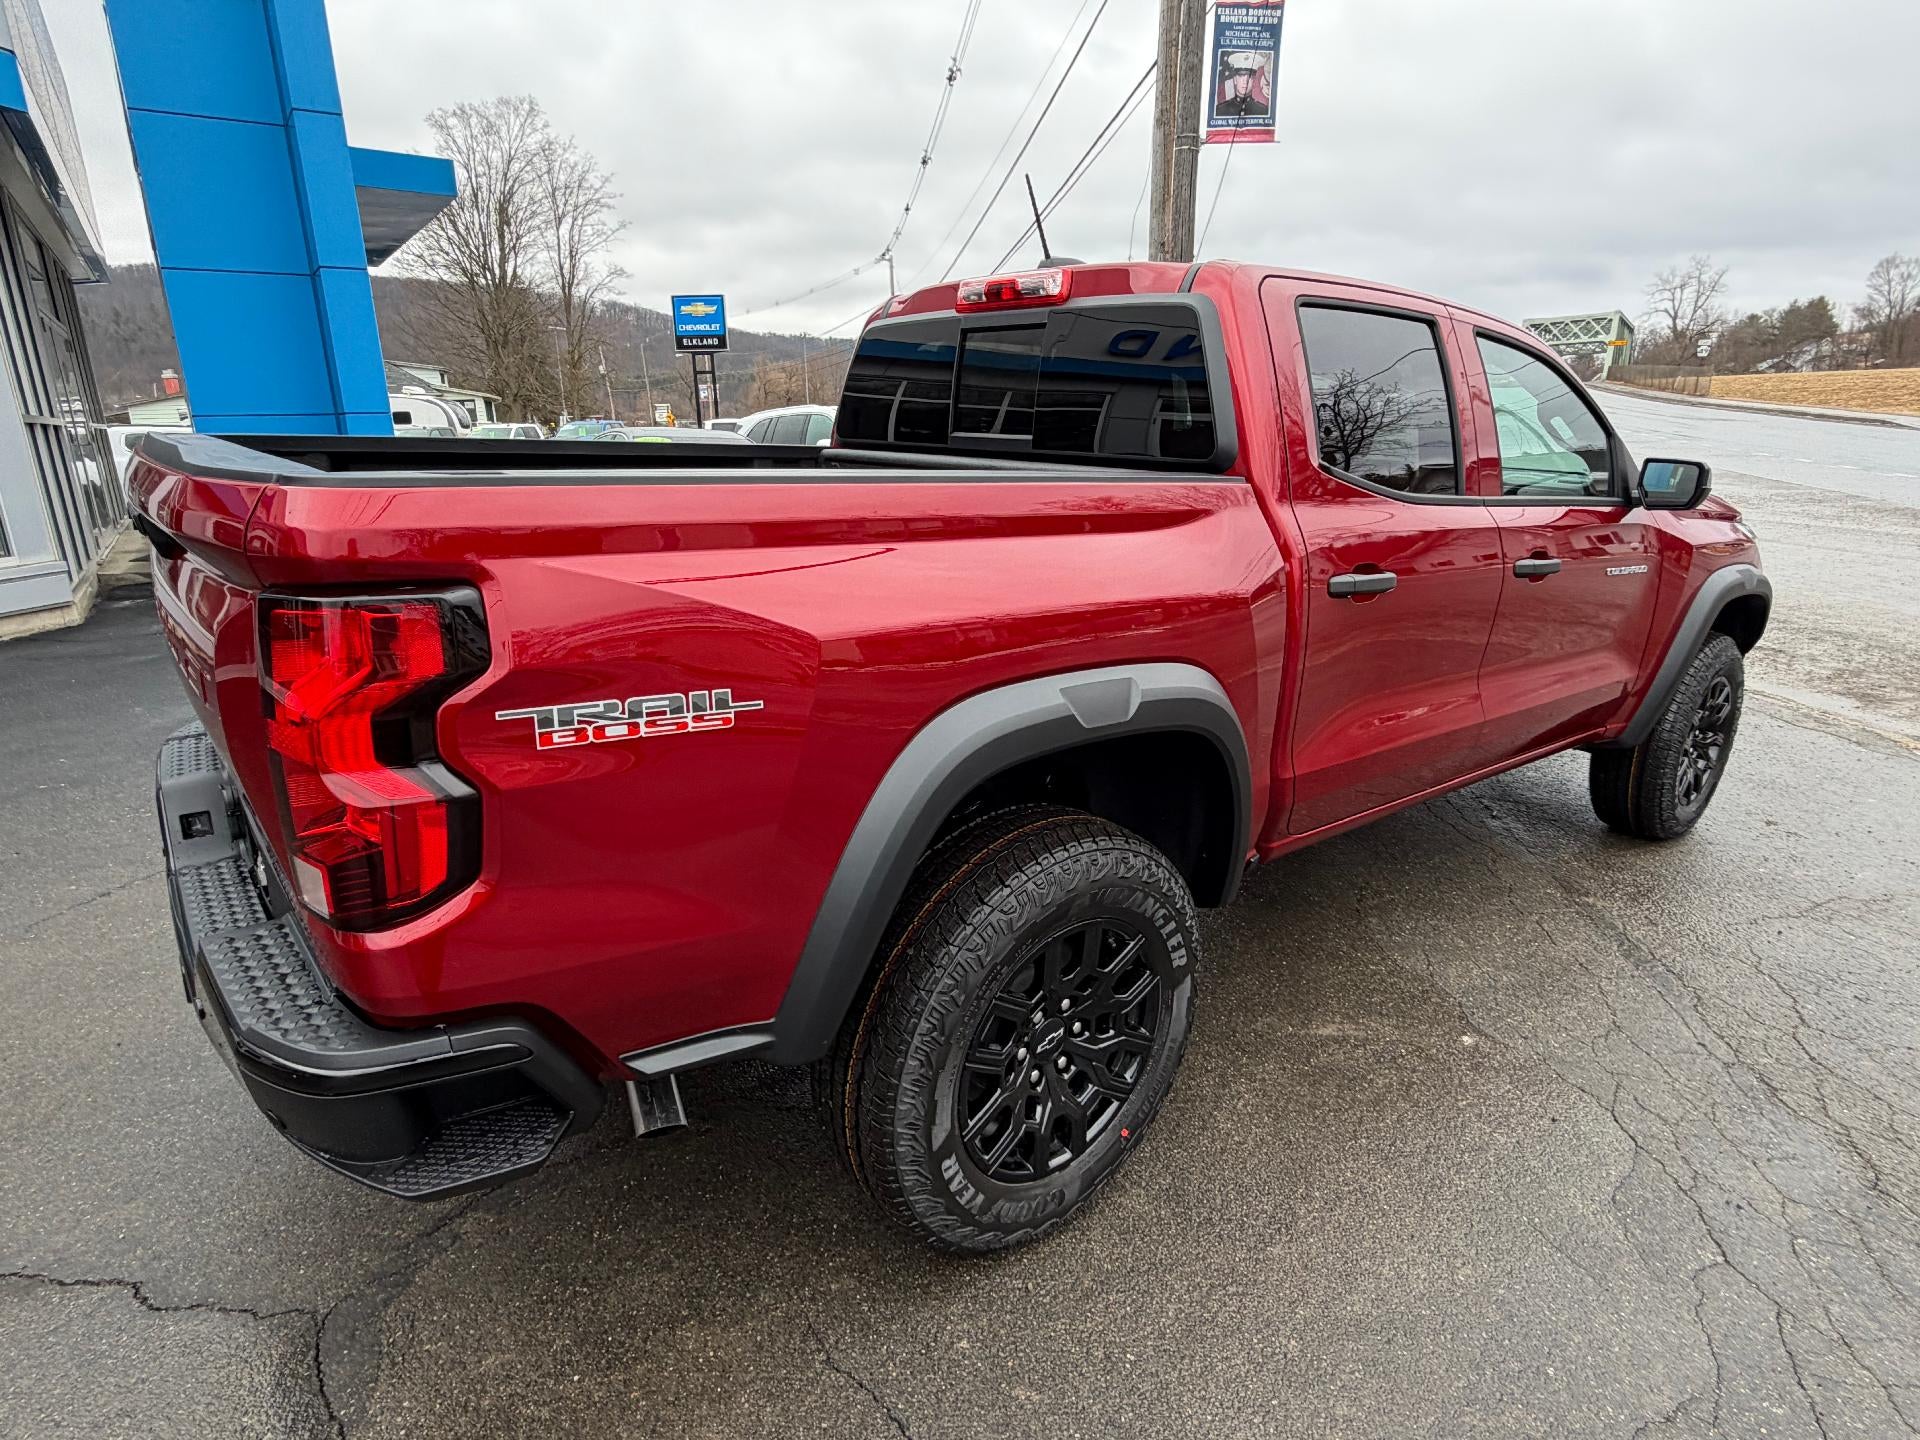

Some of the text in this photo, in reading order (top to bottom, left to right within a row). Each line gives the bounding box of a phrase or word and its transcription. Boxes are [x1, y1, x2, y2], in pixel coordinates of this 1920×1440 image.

[1217, 7, 1282, 17] ELKLAND BOROUGH
[1220, 15, 1258, 23] HOMETOWN
[679, 323, 721, 331] CHEVROLET
[683, 338, 719, 346] ELKLAND
[495, 688, 764, 731] TRAIL
[537, 710, 734, 751] BOSS
